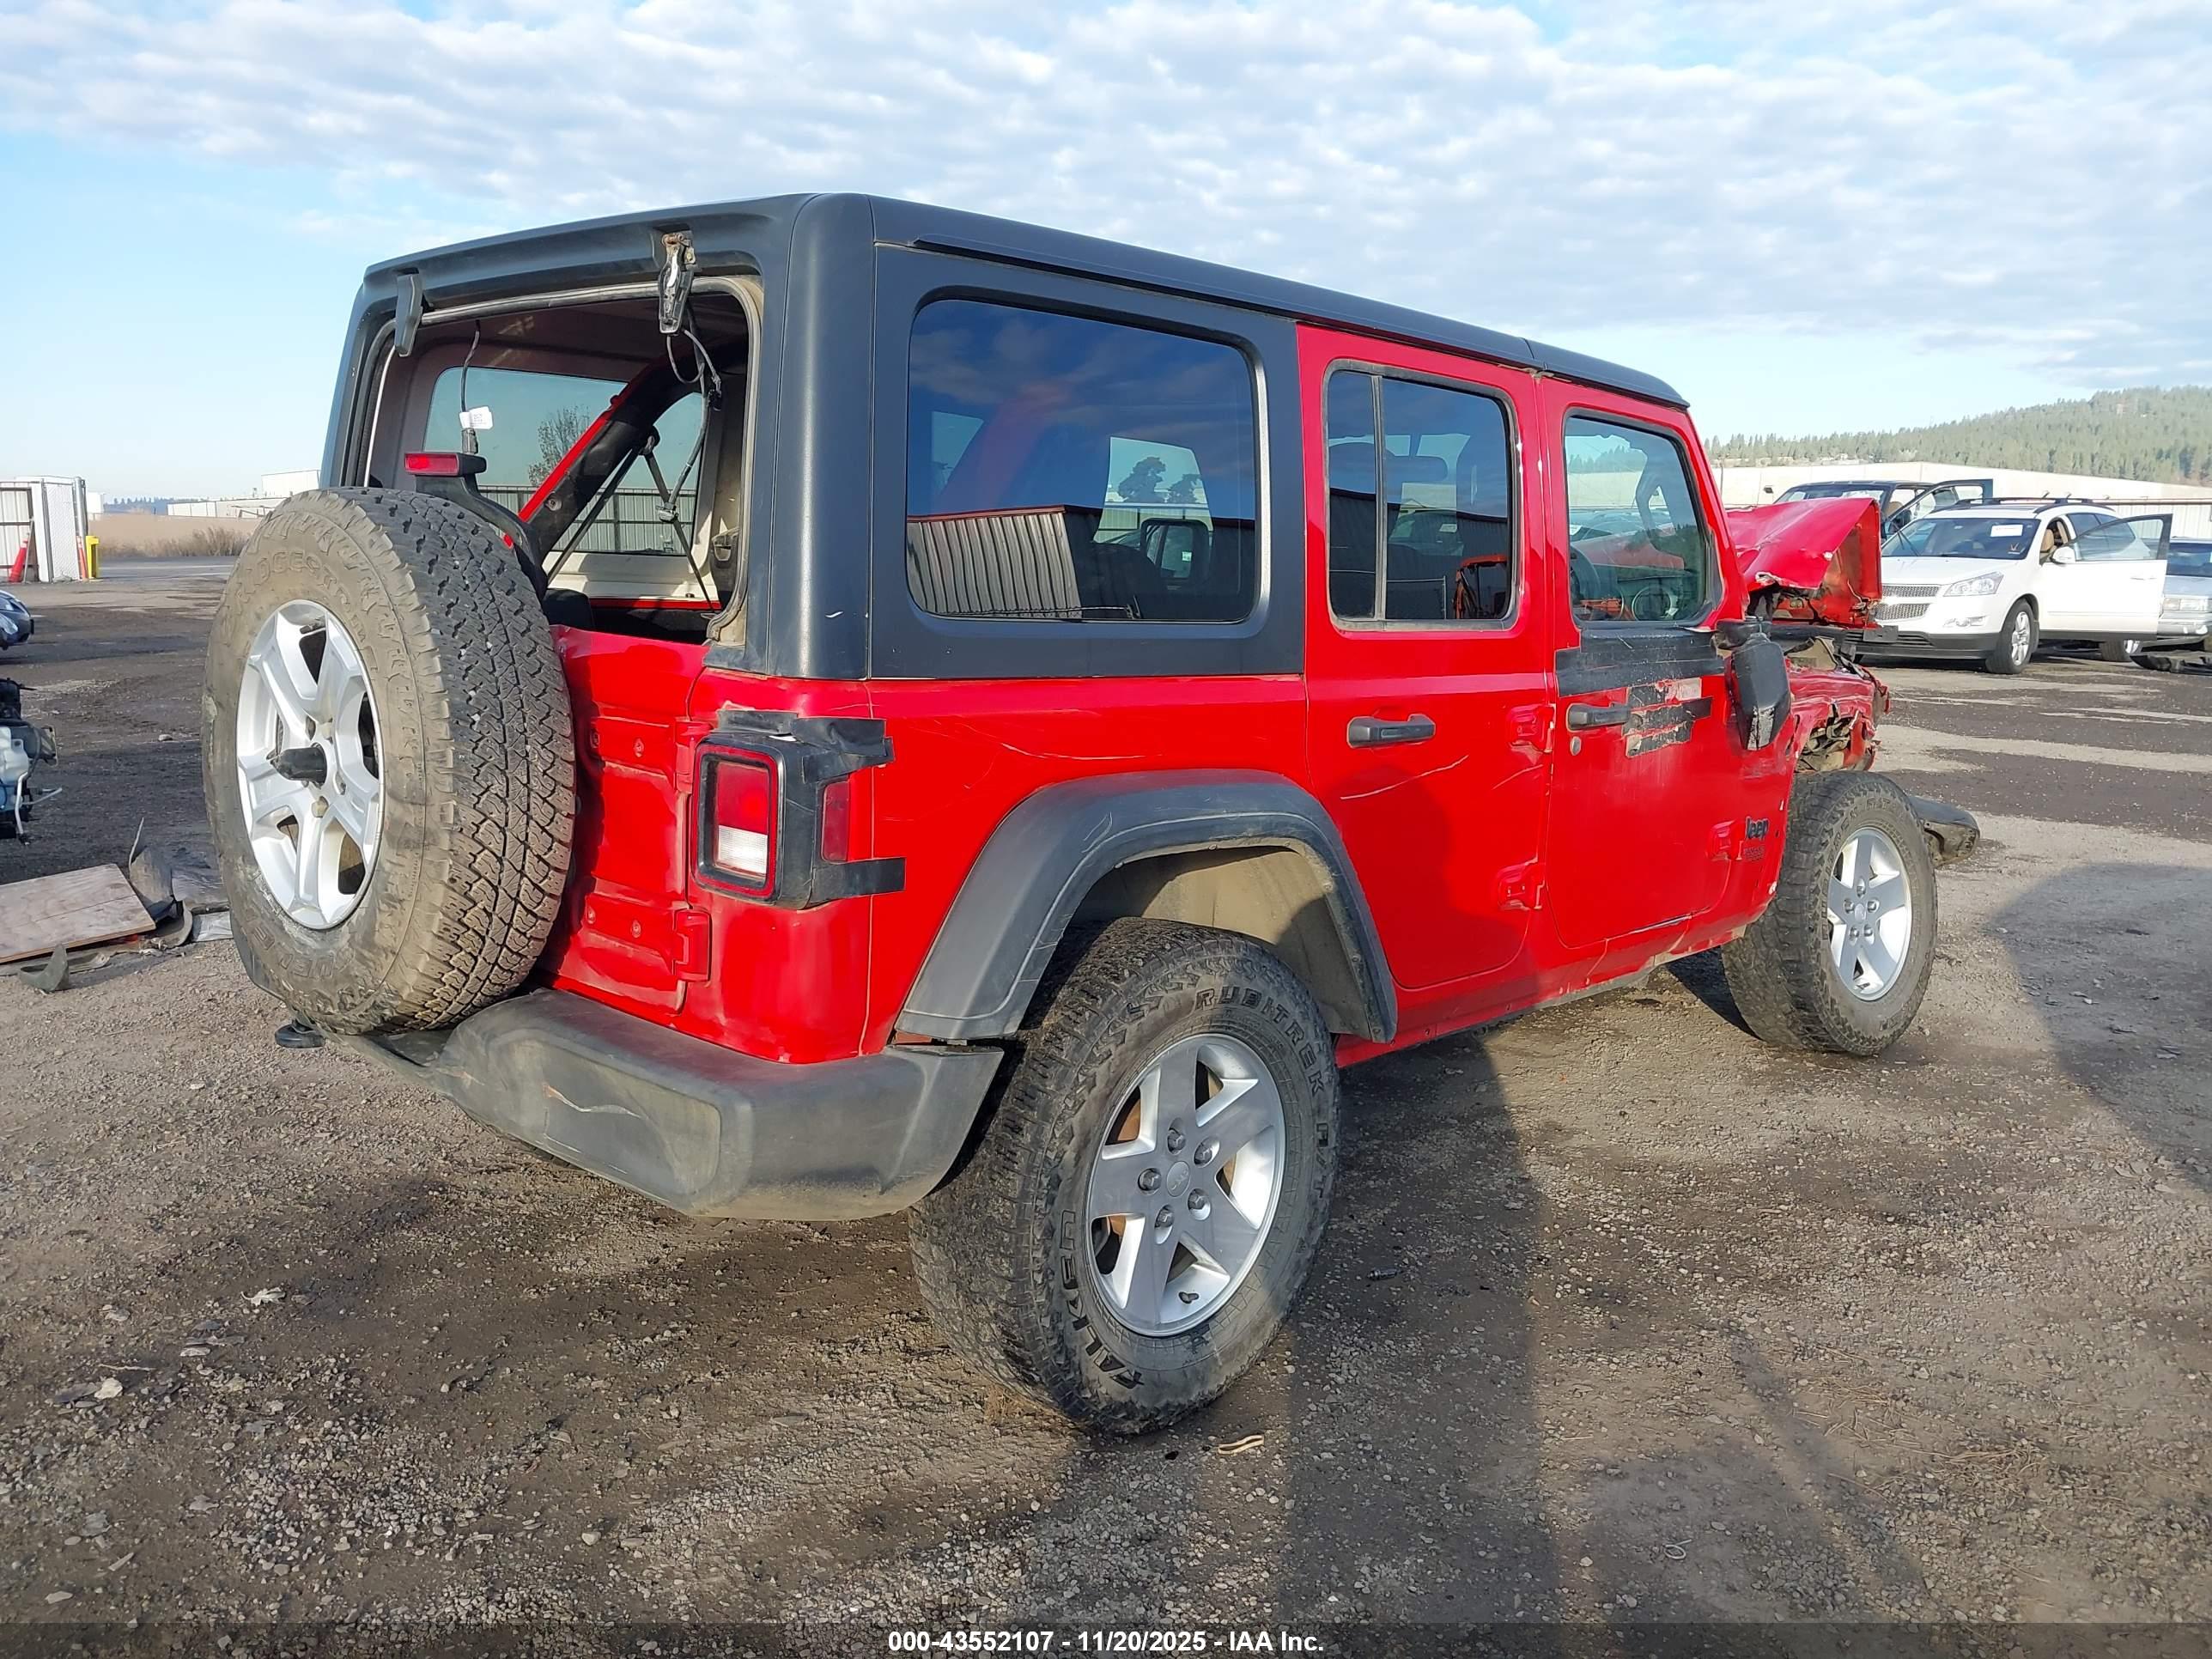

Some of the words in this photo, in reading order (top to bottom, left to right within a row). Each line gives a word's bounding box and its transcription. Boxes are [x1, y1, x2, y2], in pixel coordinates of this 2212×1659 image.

[1746, 817, 1769, 841] Jeep
[1194, 986, 1325, 1097] RUBITREK
[1059, 1209, 1145, 1389] FALKEN
